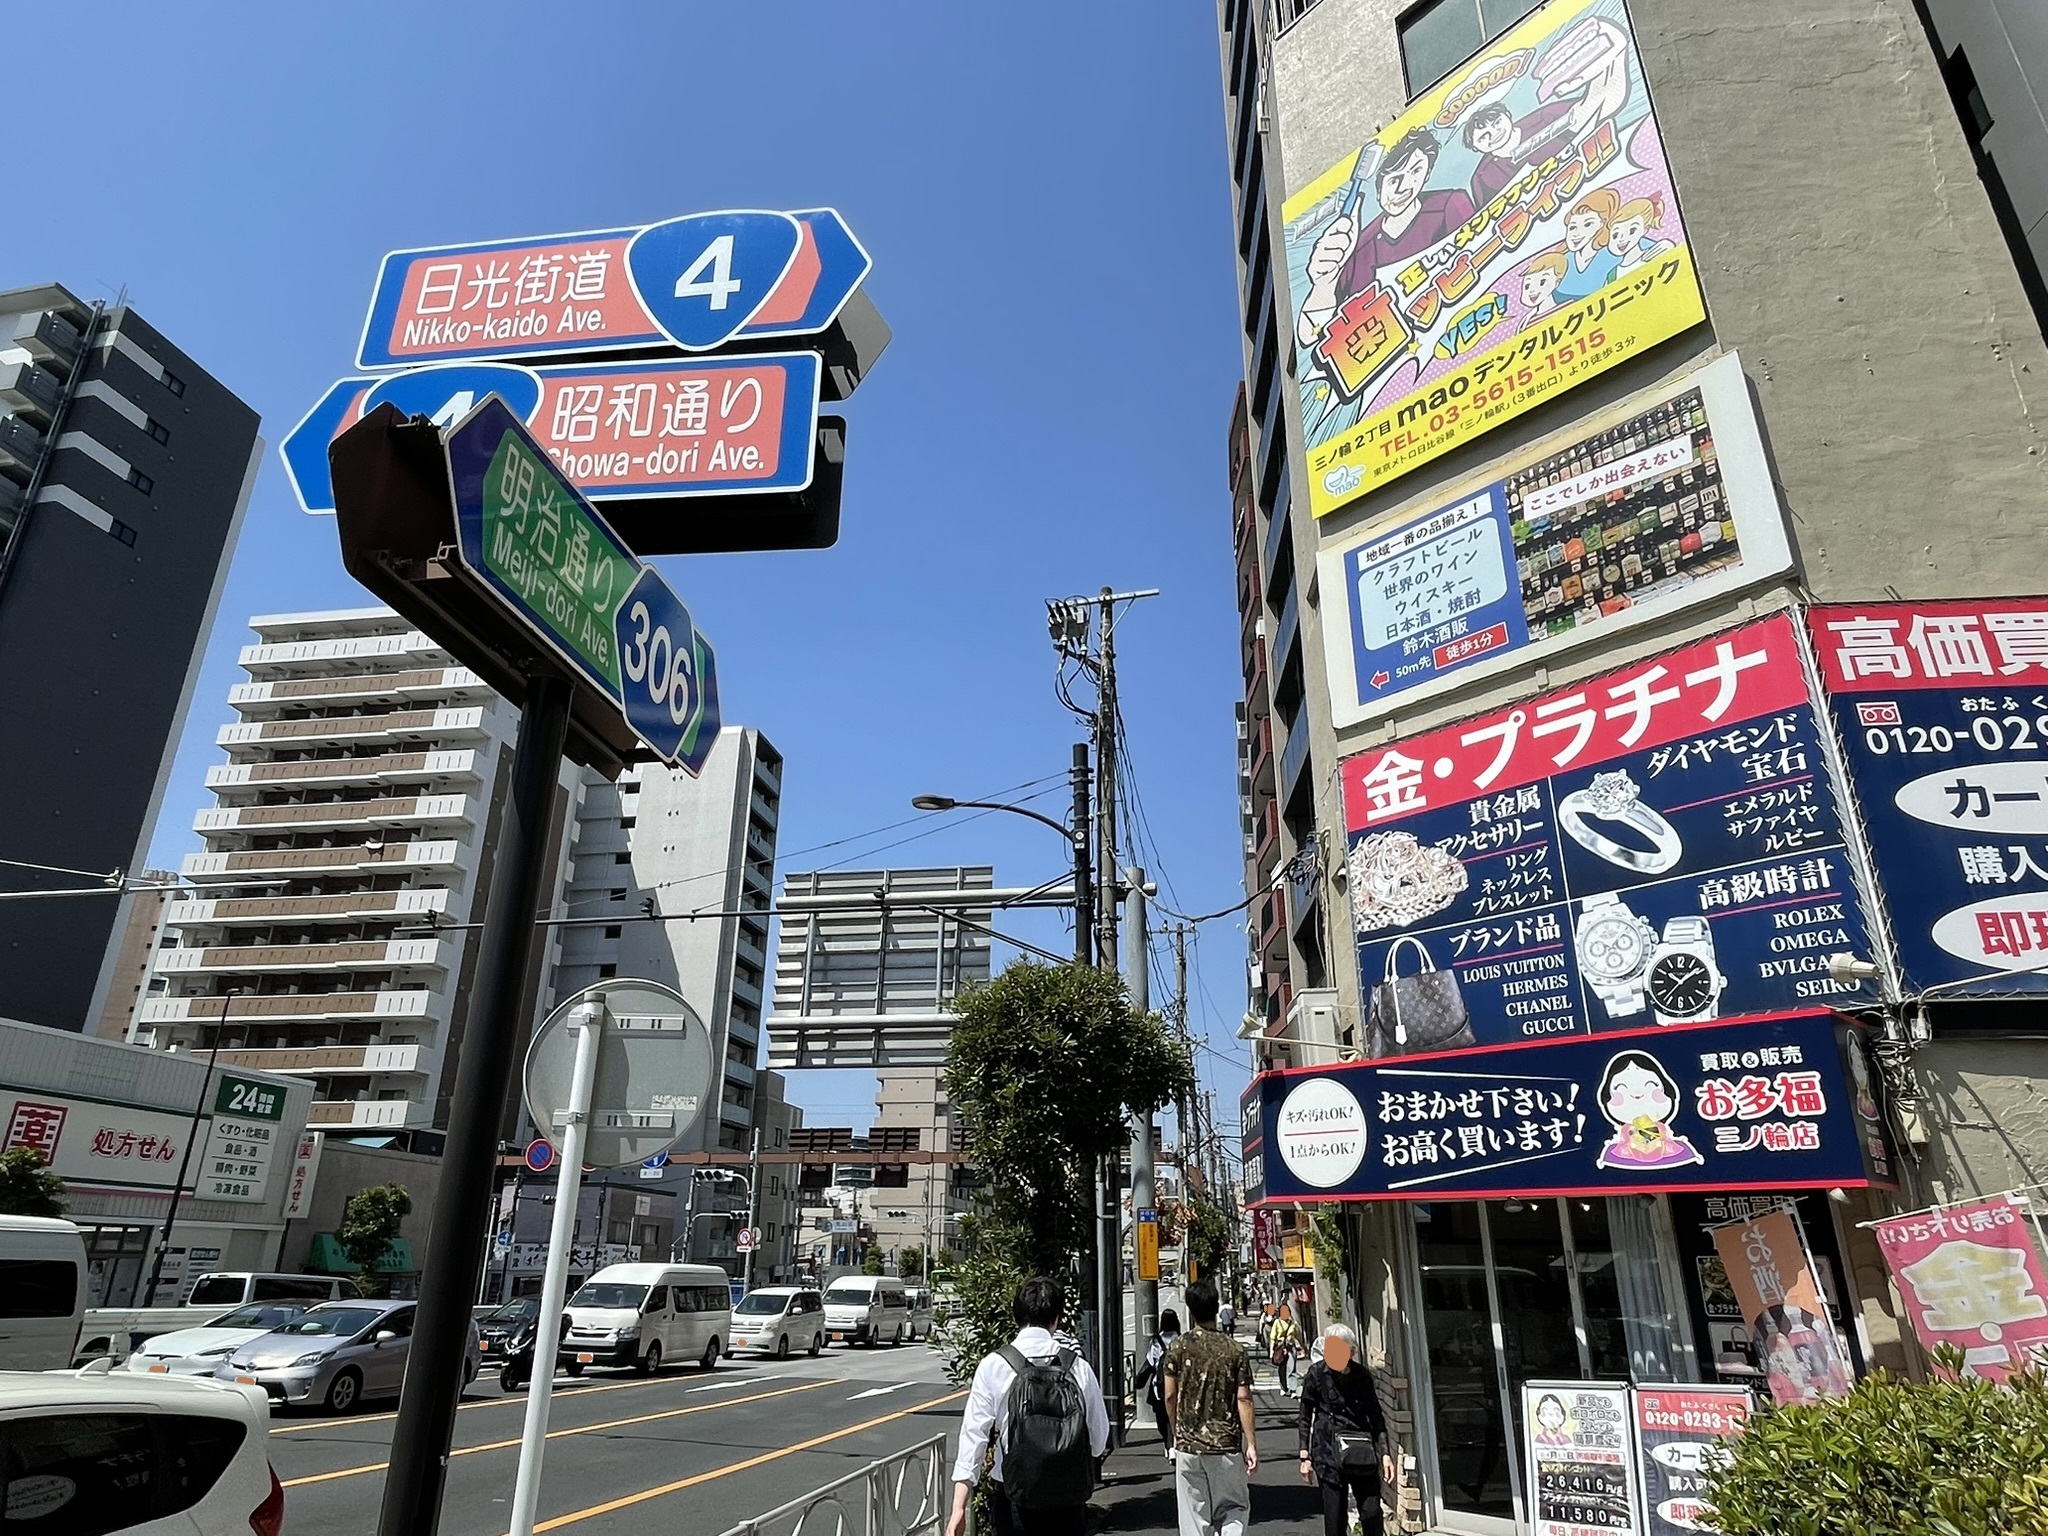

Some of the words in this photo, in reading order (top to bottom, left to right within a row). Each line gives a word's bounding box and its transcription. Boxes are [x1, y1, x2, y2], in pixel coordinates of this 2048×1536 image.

[415, 249, 612, 315] 日光街道
[674, 234, 742, 311] 4
[402, 307, 549, 348] Nikko-kaido
[556, 305, 608, 334] Ave.
[1439, 294, 1509, 357] YES!
[550, 376, 764, 443] 昭和通り
[706, 439, 765, 473] Ave.
[1335, 475, 1360, 498] mao
[1530, 446, 1687, 512] ここでしか出会えない
[500, 443, 613, 613] 明治通り
[1373, 528, 1483, 585] クラフトビール
[1383, 550, 1478, 600] 世界のワイン
[493, 521, 578, 634] Meiji-dori
[579, 614, 610, 668] Ave.
[1386, 588, 1481, 640] 日本酒・焼酎
[1395, 576, 1473, 616] ウイスキー
[1396, 657, 1432, 679] 50m先
[1446, 632, 1494, 661] 徒歩1分
[1402, 617, 1469, 657] 鈴木酒販
[1827, 612, 2048, 682] 高価買
[624, 601, 692, 726] 306
[1362, 640, 1769, 821] 金・プラチナ
[1647, 713, 1798, 779] ダイヤモンド
[1741, 742, 1808, 783] 宝石
[1468, 784, 1542, 827] 貴金属
[1723, 782, 1813, 818] エメラルド
[1944, 777, 2048, 819] カー
[1435, 818, 1544, 858] アクセサリー
[1726, 805, 1820, 839] サファイヤ
[1765, 828, 1825, 853] ルビー
[1505, 846, 1549, 871] リング
[1957, 845, 2048, 885] 購入
[1481, 867, 1552, 895] ネックレス
[1697, 857, 1835, 911] 高級時計
[1448, 912, 1561, 958] ブランド品
[1773, 904, 1846, 929] ROLEX
[1769, 928, 1851, 953] OMEGA
[1462, 963, 1501, 984] LOUIS
[1502, 953, 1566, 976] VUITTON
[1502, 973, 1569, 998] HERMES
[1758, 951, 1855, 979] BVLGA
[1505, 994, 1573, 1017] CHANEL
[1522, 1015, 1576, 1036] GUCCI
[228, 1083, 259, 1113] 24
[1376, 1082, 1580, 1124] おまかせ下さい!
[1696, 1071, 1826, 1119] お多福
[91, 1128, 175, 1162] 処方せん
[1289, 1142, 1356, 1159] 1点からOK!
[1380, 1113, 1587, 1168] お高く買います!
[1714, 1121, 1821, 1152] 三ノ輪店
[288, 1165, 307, 1213] 処方せん
[1546, 1475, 1604, 1491] 26,416
[1549, 1505, 1608, 1523] 11,580
